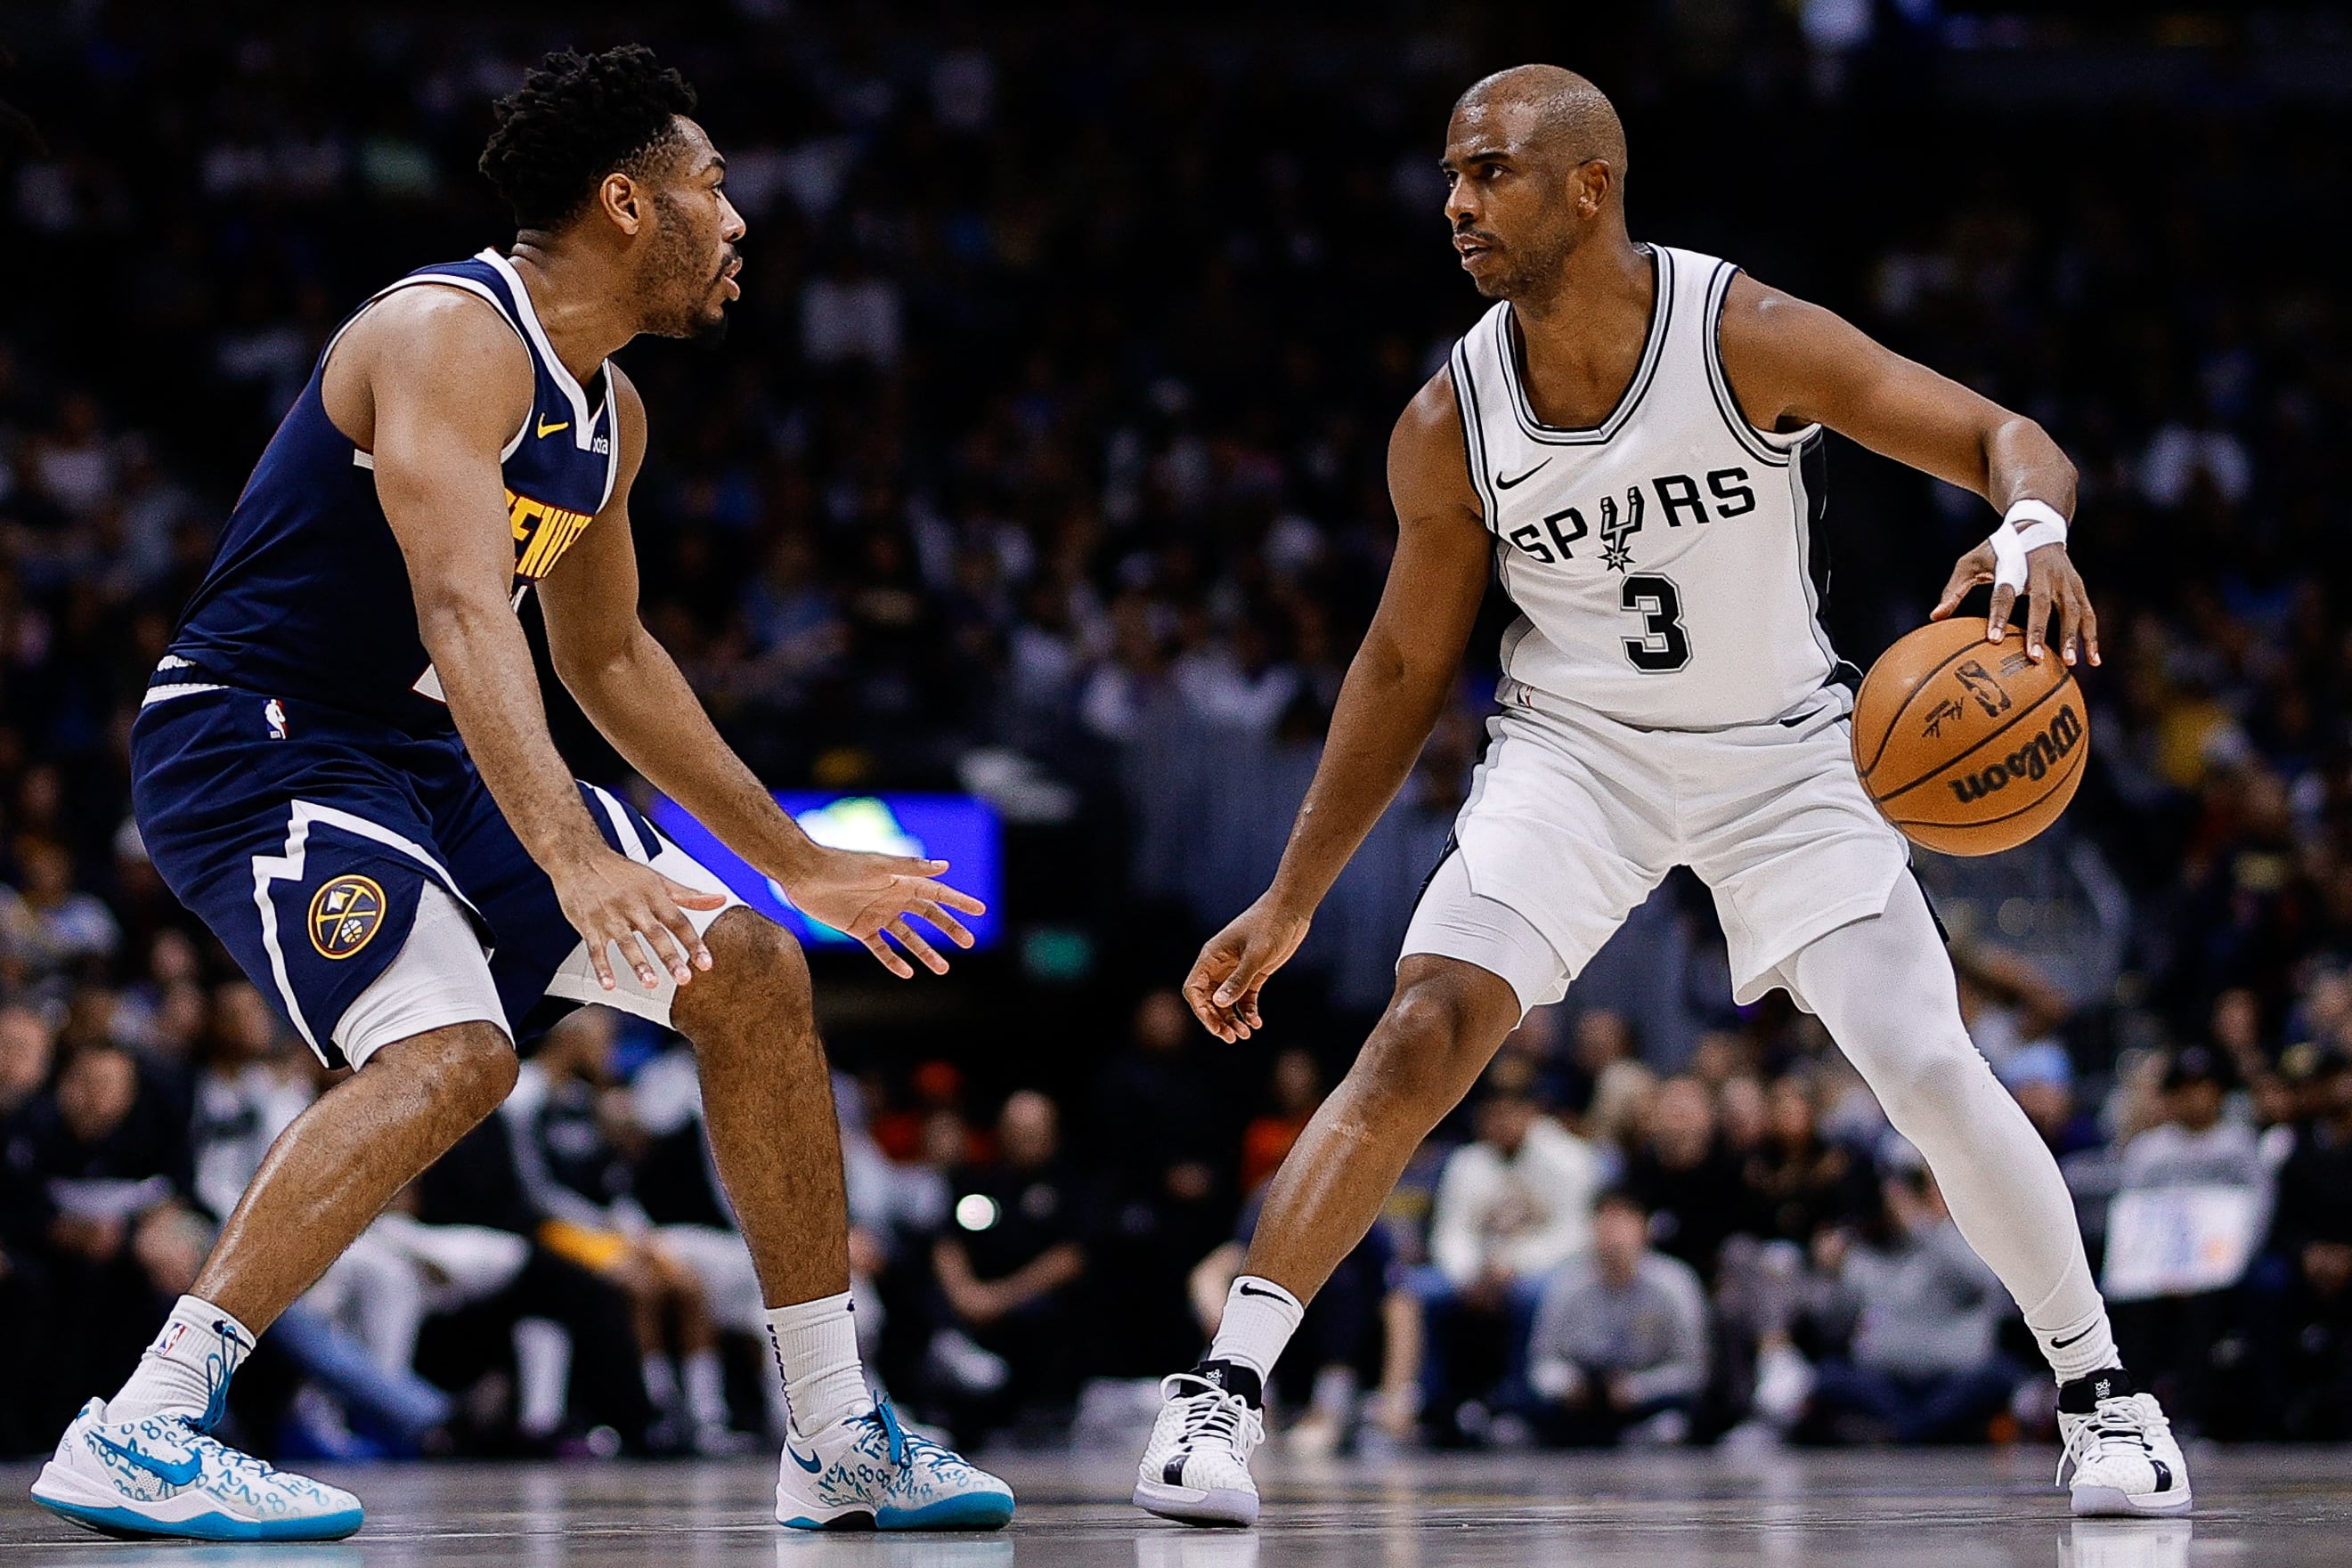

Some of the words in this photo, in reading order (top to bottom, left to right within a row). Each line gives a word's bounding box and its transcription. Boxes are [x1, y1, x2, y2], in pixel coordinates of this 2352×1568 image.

[1510, 466, 1756, 574] SPURS
[1619, 571, 1694, 675] 3
[1948, 703, 2082, 803] Wilson
